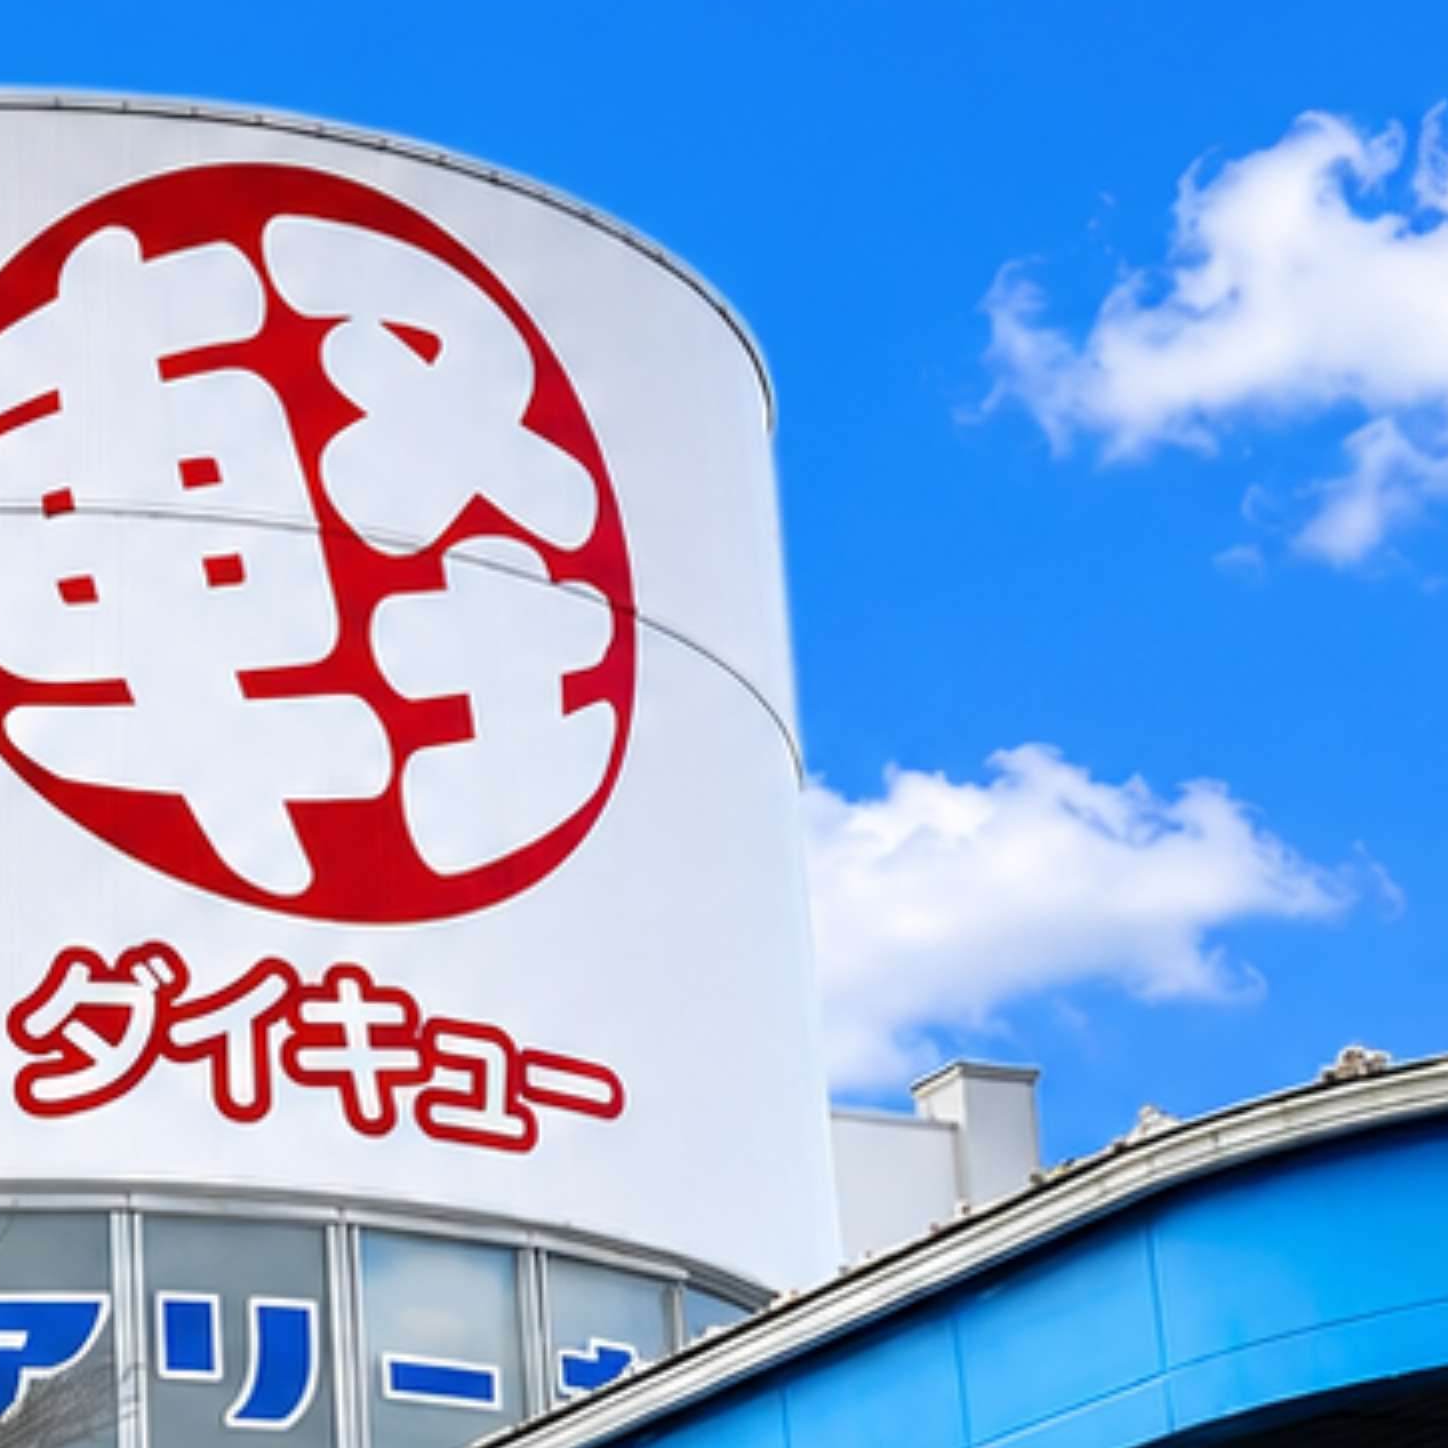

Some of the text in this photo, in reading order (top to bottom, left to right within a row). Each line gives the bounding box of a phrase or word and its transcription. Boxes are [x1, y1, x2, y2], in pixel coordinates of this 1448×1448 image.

[6, 940, 625, 1153] ダイキュー
